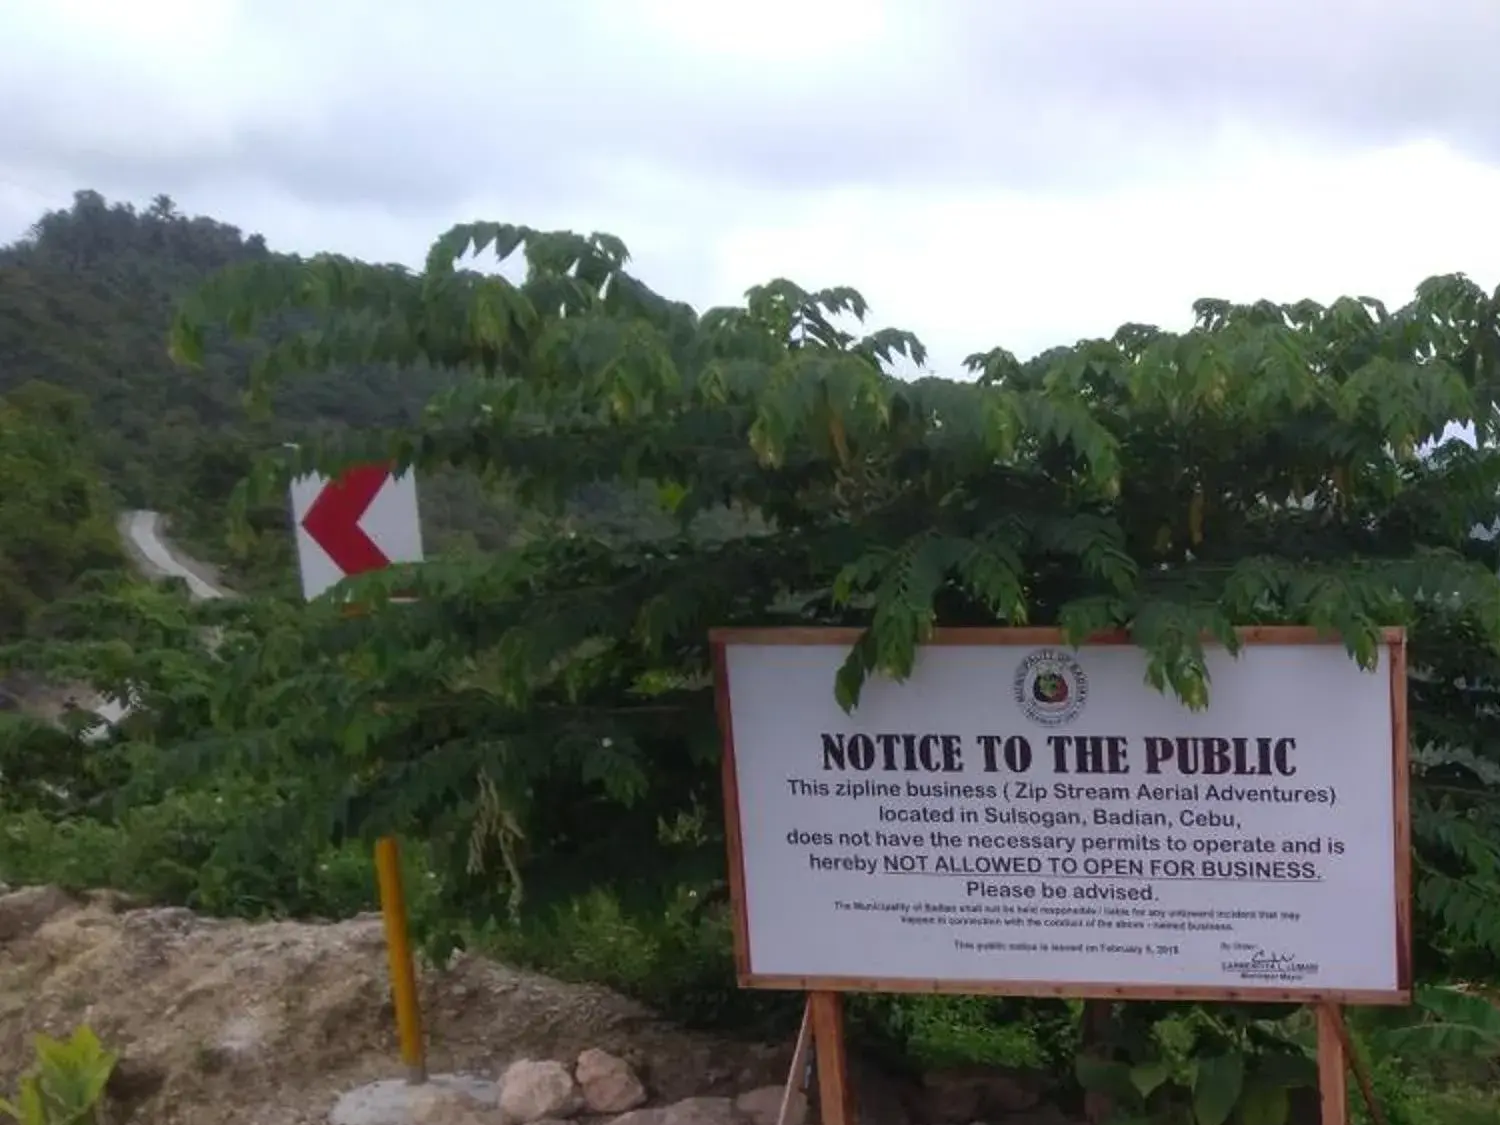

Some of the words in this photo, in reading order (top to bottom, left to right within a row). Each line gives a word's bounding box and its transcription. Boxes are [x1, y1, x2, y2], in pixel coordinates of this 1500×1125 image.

[821, 733, 963, 771] NOTICE
[976, 735, 1032, 773] TO
[1047, 735, 1130, 774] THE
[1143, 737, 1297, 776] PUBLIC
[787, 779, 828, 797] This
[835, 780, 901, 800] zipline
[906, 781, 997, 798] business
[1054, 783, 1130, 801] Stream
[1137, 783, 1199, 802] Aerial
[1205, 784, 1337, 807] Adventures)
[879, 806, 954, 823] located
[960, 806, 978, 823] in
[984, 807, 1087, 828] Sulsogan,
[1093, 808, 1174, 829] Badian,
[1179, 809, 1242, 830] Cebu,
[786, 829, 833, 846] does
[838, 831, 870, 847] not
[876, 831, 925, 848] have
[930, 832, 962, 848] the
[967, 835, 1076, 853] necessary
[1081, 835, 1161, 856] permits
[1166, 837, 1187, 851] to
[1193, 837, 1275, 857] operate
[1281, 838, 1321, 854] and
[1328, 838, 1345, 854] is
[809, 853, 878, 875] hereby
[884, 855, 929, 873] NOT
[935, 856, 1042, 873] ALLOWED
[1047, 857, 1078, 875] TO
[1083, 858, 1143, 876] OPEN
[1150, 859, 1196, 877] FOR
[1202, 860, 1322, 880] BUSINESS.
[833, 900, 851, 910] The
[966, 881, 1036, 899] Please
[1041, 881, 1067, 899] be
[1073, 884, 1159, 902] advised.
